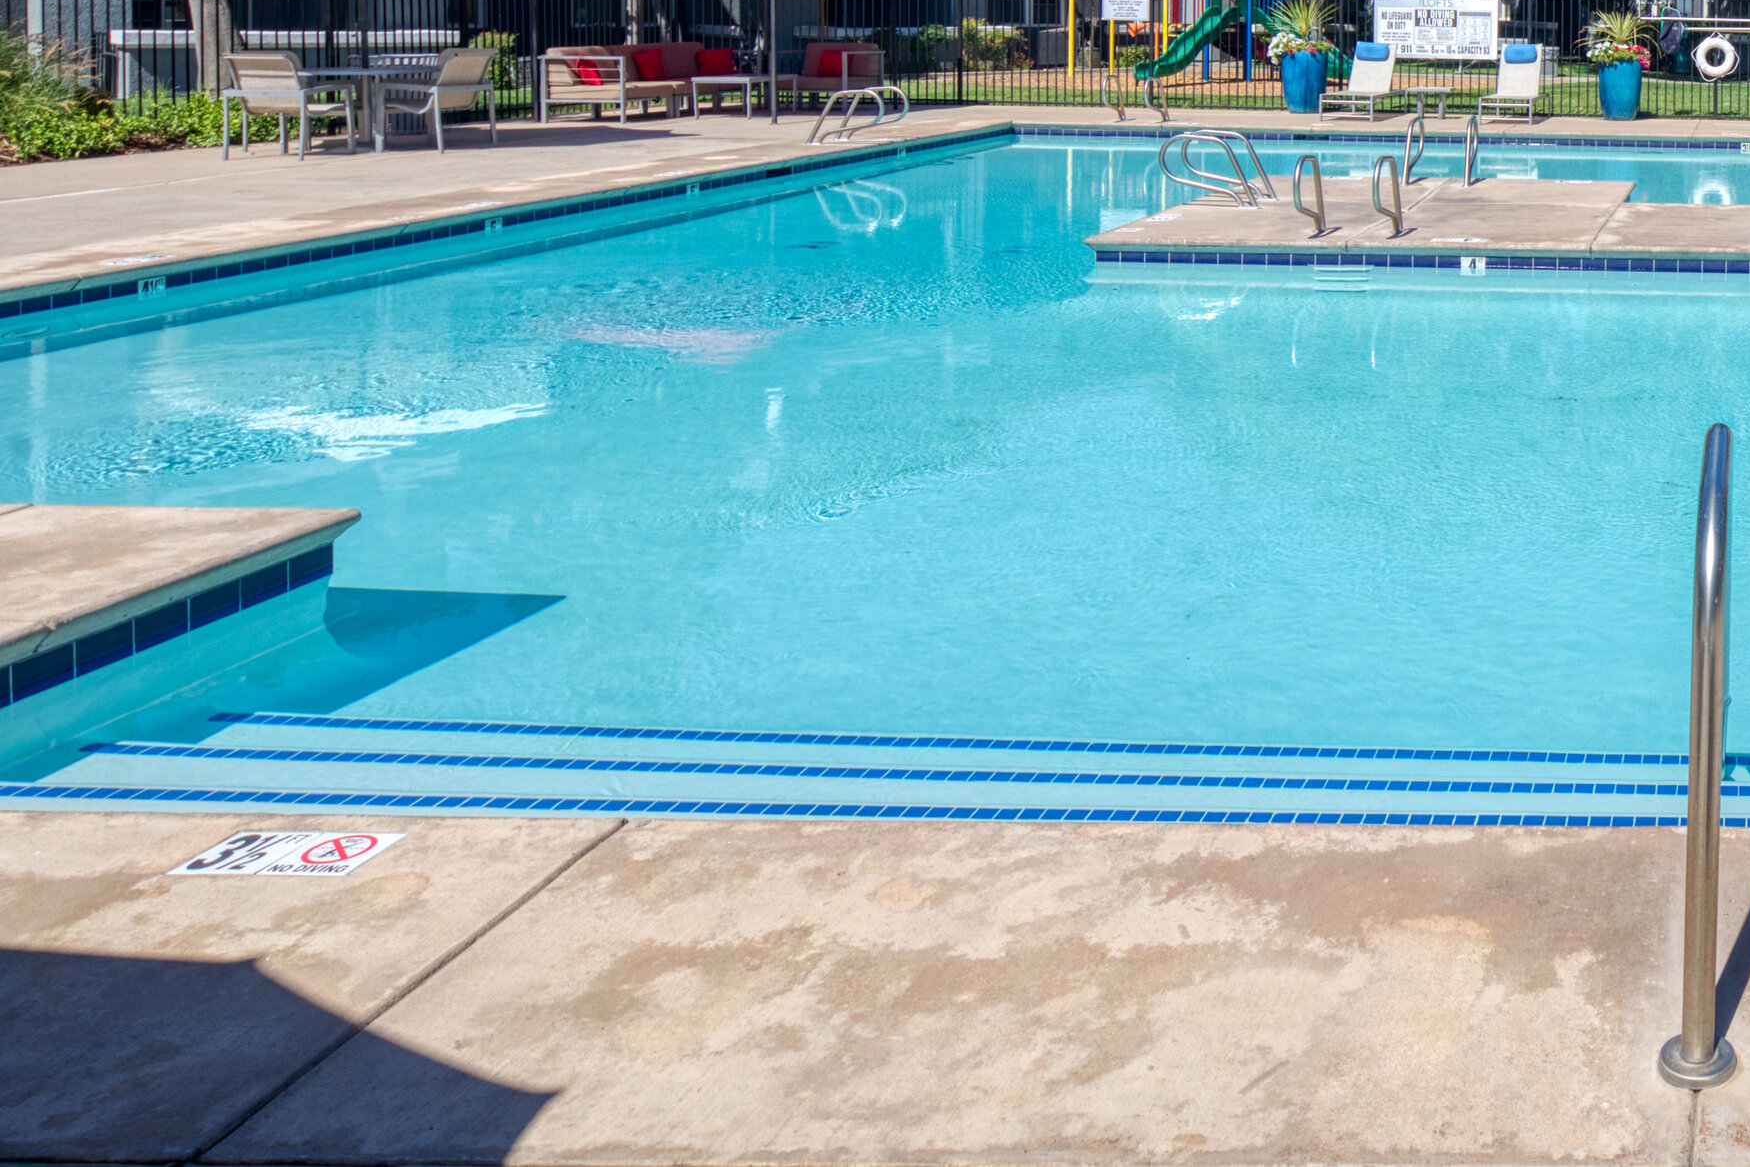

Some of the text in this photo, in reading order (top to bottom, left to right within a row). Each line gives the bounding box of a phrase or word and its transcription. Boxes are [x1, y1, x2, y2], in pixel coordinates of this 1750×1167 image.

[1381, 12, 1412, 20] NO LIFEGUARD
[1417, 10, 1427, 18] NO
[1430, 10, 1455, 18] DIVING
[1387, 21, 1405, 29] ON DUTY
[1419, 18, 1453, 27] ALLOWED
[1401, 44, 1412, 54] 911
[1457, 45, 1490, 54] CAPACITY 93
[284, 834, 313, 844] FT
[266, 864, 350, 873] NO DIVING
